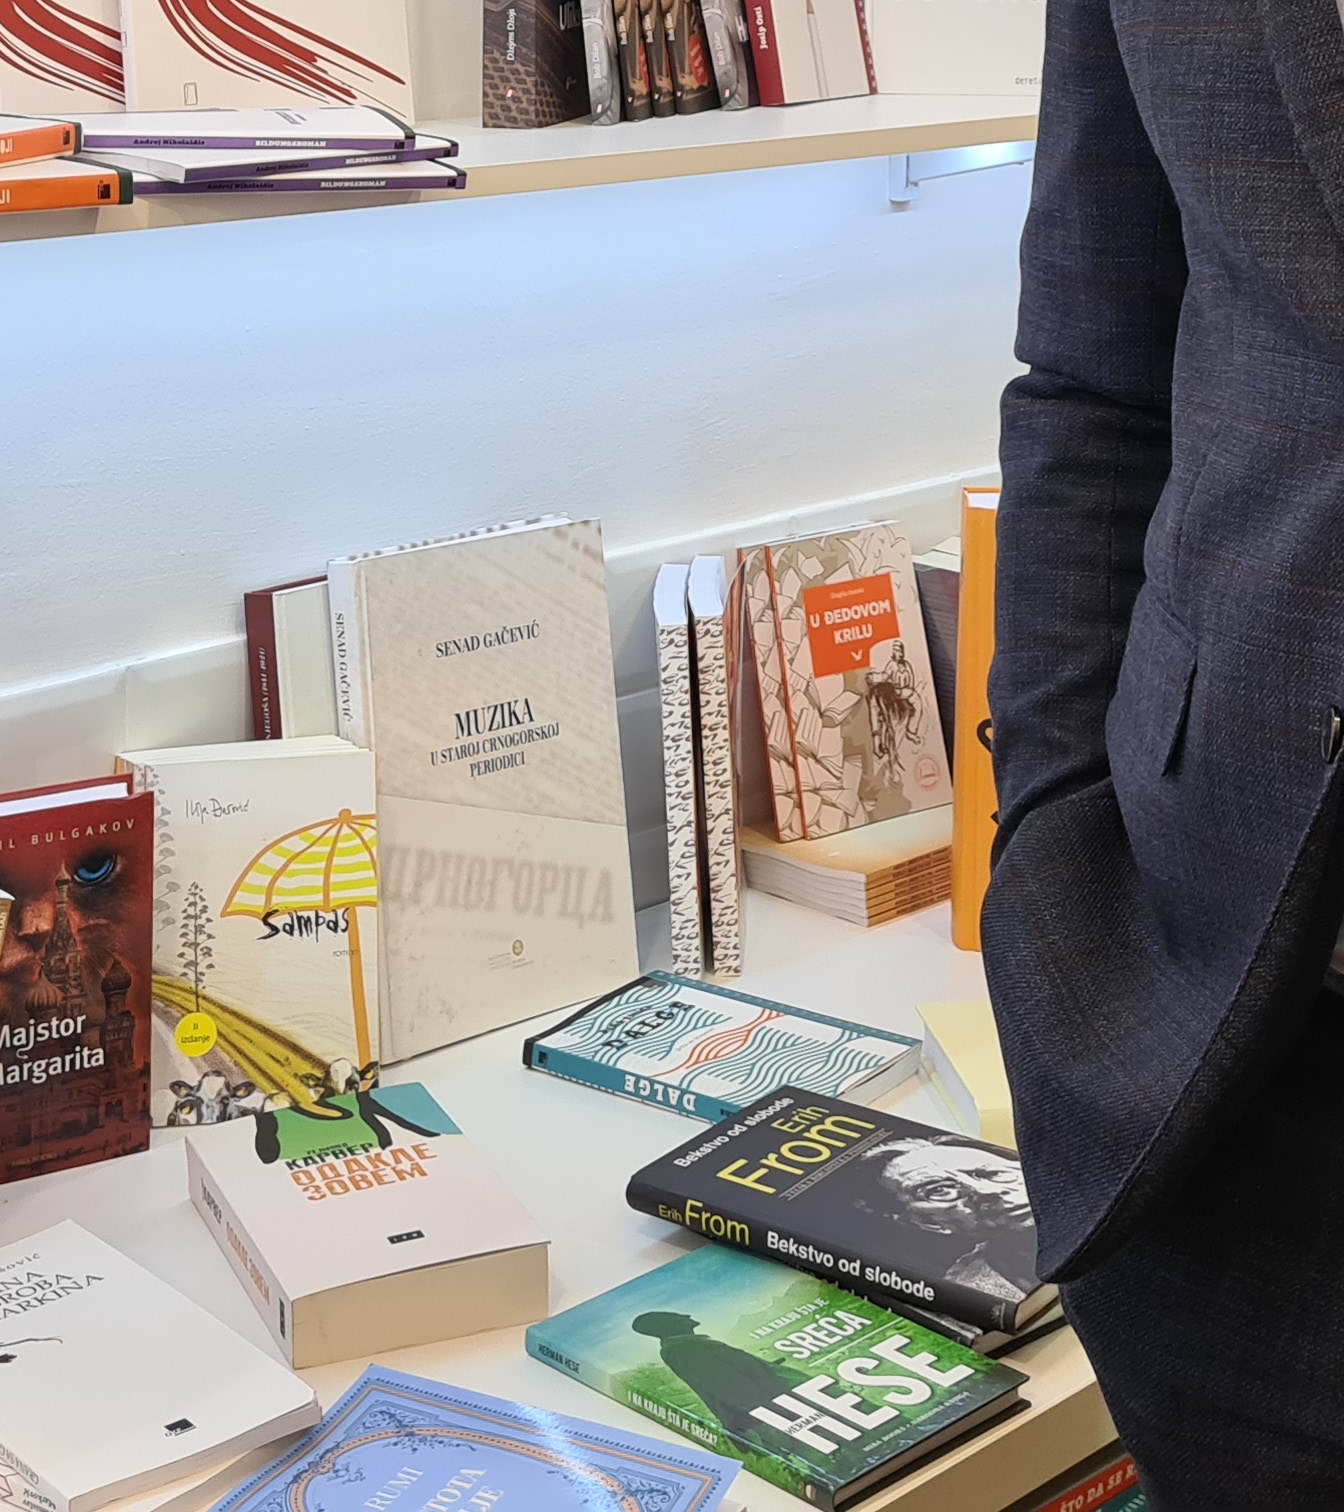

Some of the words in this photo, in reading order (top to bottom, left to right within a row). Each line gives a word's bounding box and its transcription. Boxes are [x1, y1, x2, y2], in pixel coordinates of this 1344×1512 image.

[757, 24, 768, 49] Josip
[593, 59, 602, 80] Bob
[255, 140, 326, 148] BILDUNGSROMAN
[810, 613, 820, 628] U
[824, 599, 891, 625] ĐEDOVOM
[435, 635, 480, 659] SENAD
[483, 619, 540, 649] GAČEVIĆ
[833, 623, 873, 644] KRILU
[454, 697, 536, 740] MUZIKA
[430, 750, 439, 767] U
[440, 740, 481, 765] STAROJ
[482, 722, 560, 755] CRNOGORSKOJ
[468, 750, 526, 778] PERIODICI
[31, 818, 136, 846] BULGAKOV
[257, 907, 350, 943] Sampas
[181, 1032, 211, 1044] izdanje
[623, 1073, 697, 1112] DALGE
[672, 1132, 730, 1169] Bekstvo
[727, 1123, 747, 1139] od
[745, 1096, 795, 1128] slobode
[770, 1105, 831, 1134] Erih
[286, 1142, 373, 1170] КАРВЕР
[290, 1143, 438, 1186] ОДАКЛЕ
[716, 1115, 877, 1195] From
[302, 1162, 428, 1200] ЗОВЕМ
[658, 1202, 683, 1223] Erih
[684, 1198, 750, 1246] From
[766, 1230, 835, 1269] Bekstvo
[837, 1258, 861, 1277] od
[864, 1264, 936, 1302] slobode
[774, 1309, 873, 1359] SREĆA
[537, 1343, 564, 1367] HERMAN
[563, 1356, 581, 1375] HESE
[748, 1334, 975, 1455] HESE
[363, 1464, 425, 1512] RUMI
